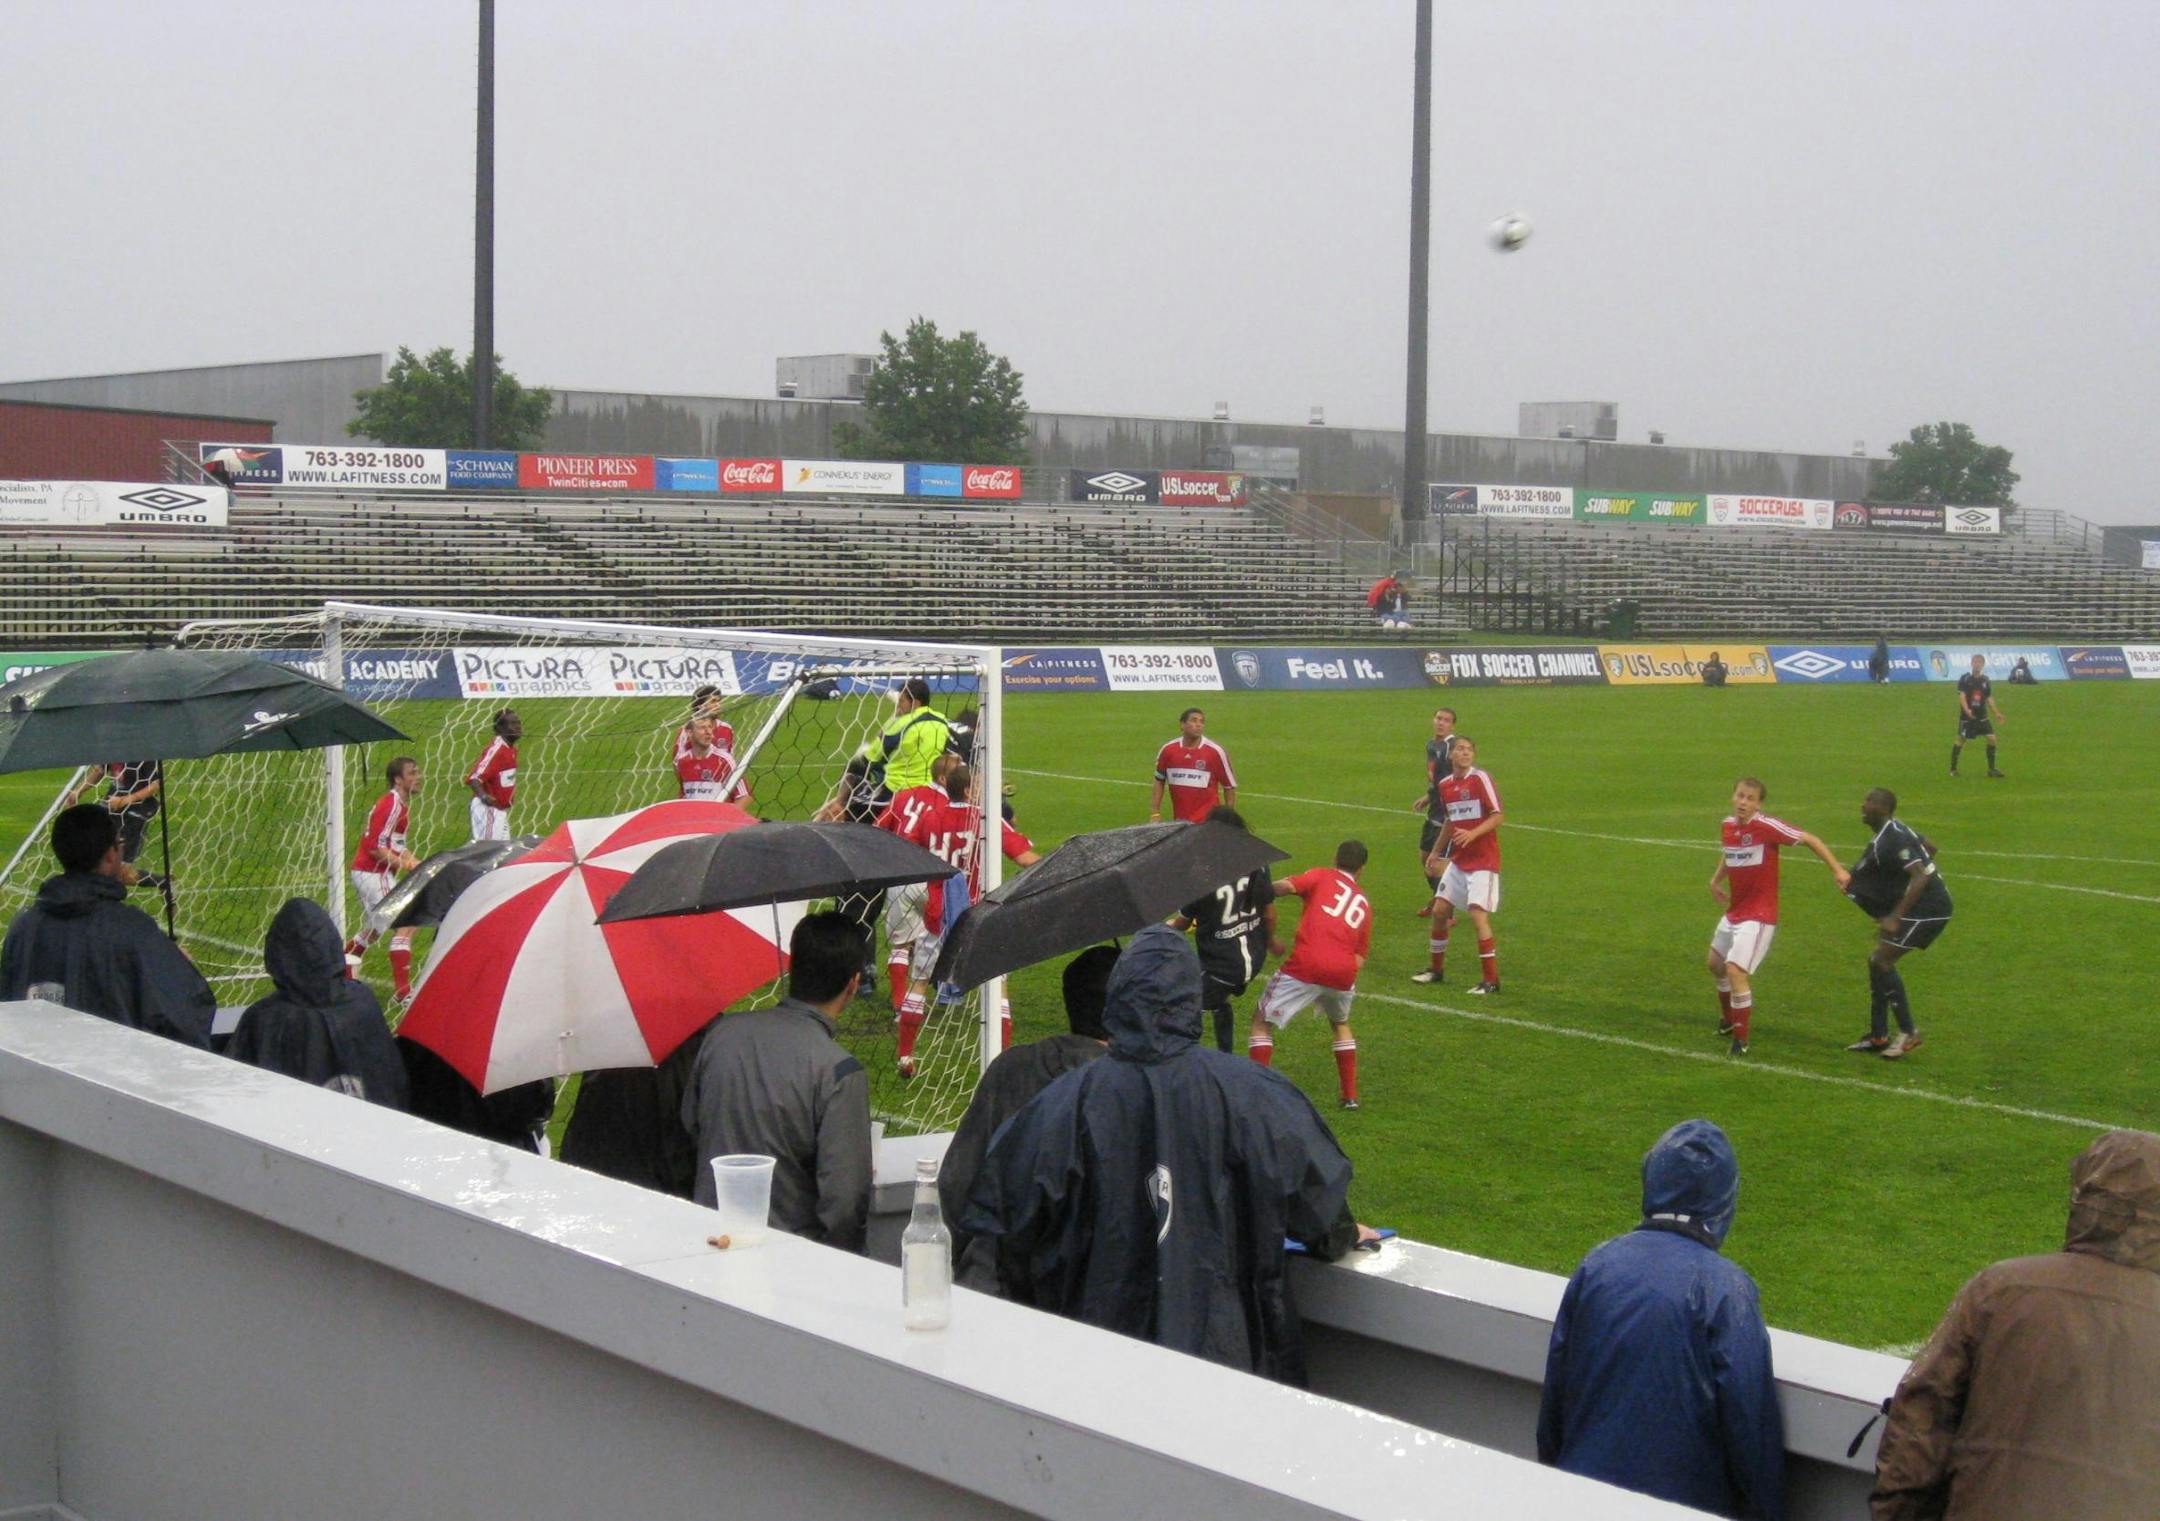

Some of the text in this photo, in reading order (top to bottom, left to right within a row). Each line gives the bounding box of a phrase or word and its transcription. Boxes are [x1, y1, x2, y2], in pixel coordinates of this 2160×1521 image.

[305, 451, 425, 468] 763-392-1800
[456, 460, 513, 471] SCHWAN
[537, 457, 637, 475] PIONEER PRESS
[288, 470, 442, 484] WWW.LAFITNESS.COM
[547, 477, 628, 488] TwinCities.com
[813, 470, 892, 480] CONNEXUS ENERGY
[1087, 493, 1146, 502] UMBRO
[1490, 489, 1561, 502] 763-392-1800
[1584, 498, 1636, 515] SUBWAY
[1649, 499, 1698, 517] SUBWAY
[1739, 498, 1804, 517] SOCCERUSA
[119, 512, 207, 523] UMBRO
[462, 653, 584, 680] PICTURA
[610, 652, 724, 680] PICTURA
[1108, 654, 1213, 669] 763-392-1800
[1286, 656, 1385, 680] Feel It.
[1451, 653, 1602, 678] FOX SOCCER CHANNEL
[1850, 659, 1921, 670] URO
[351, 660, 438, 680] ACADEMY
[507, 679, 592, 695] graphics
[1005, 674, 1041, 684] Exercise
[1043, 676, 1062, 685] your
[1112, 674, 1217, 684] WWW.LAFITNESS.COM
[1320, 879, 1369, 929] 36
